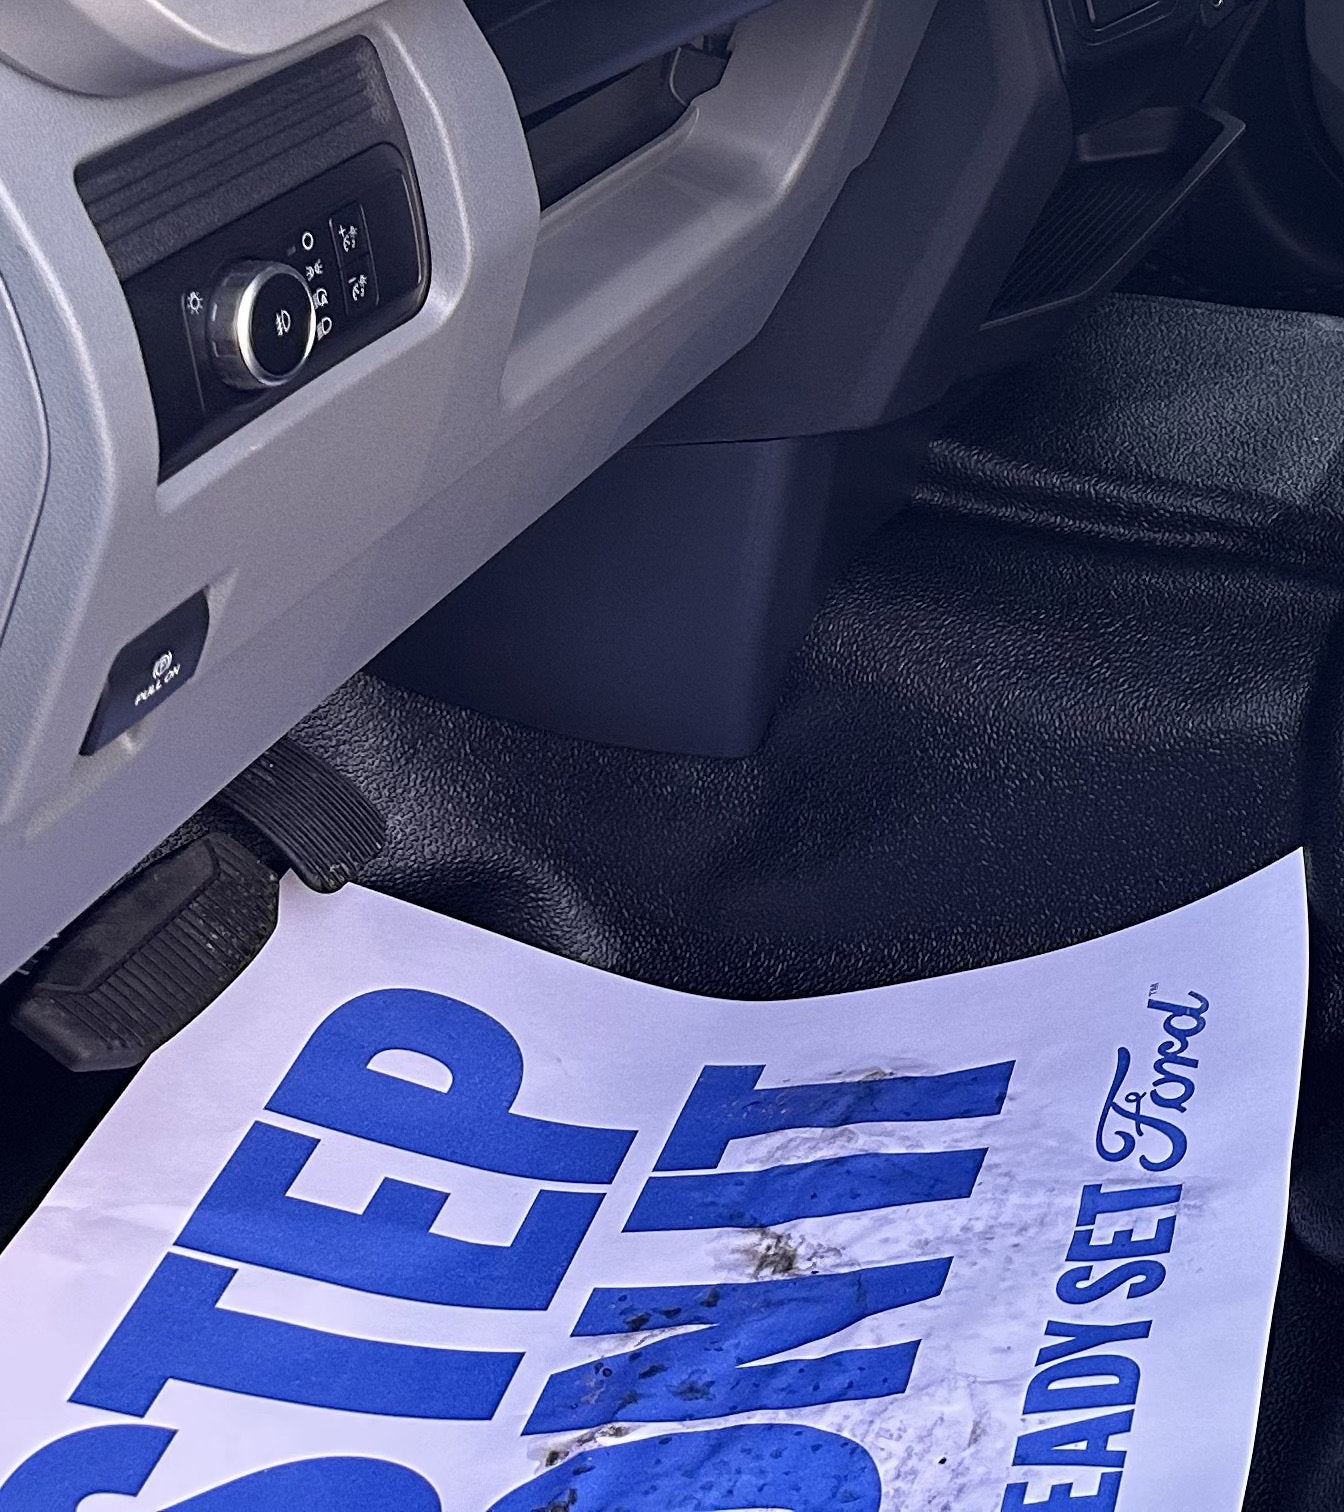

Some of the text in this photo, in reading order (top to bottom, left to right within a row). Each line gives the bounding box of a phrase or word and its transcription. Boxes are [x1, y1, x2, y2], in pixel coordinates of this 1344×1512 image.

[134, 663, 181, 707] PULL ON
[620, 1059, 1017, 1234] IT
[1095, 990, 1210, 1173] Ford
[1055, 1182, 1184, 1305] SET
[1000, 1319, 1154, 1512] EADY
